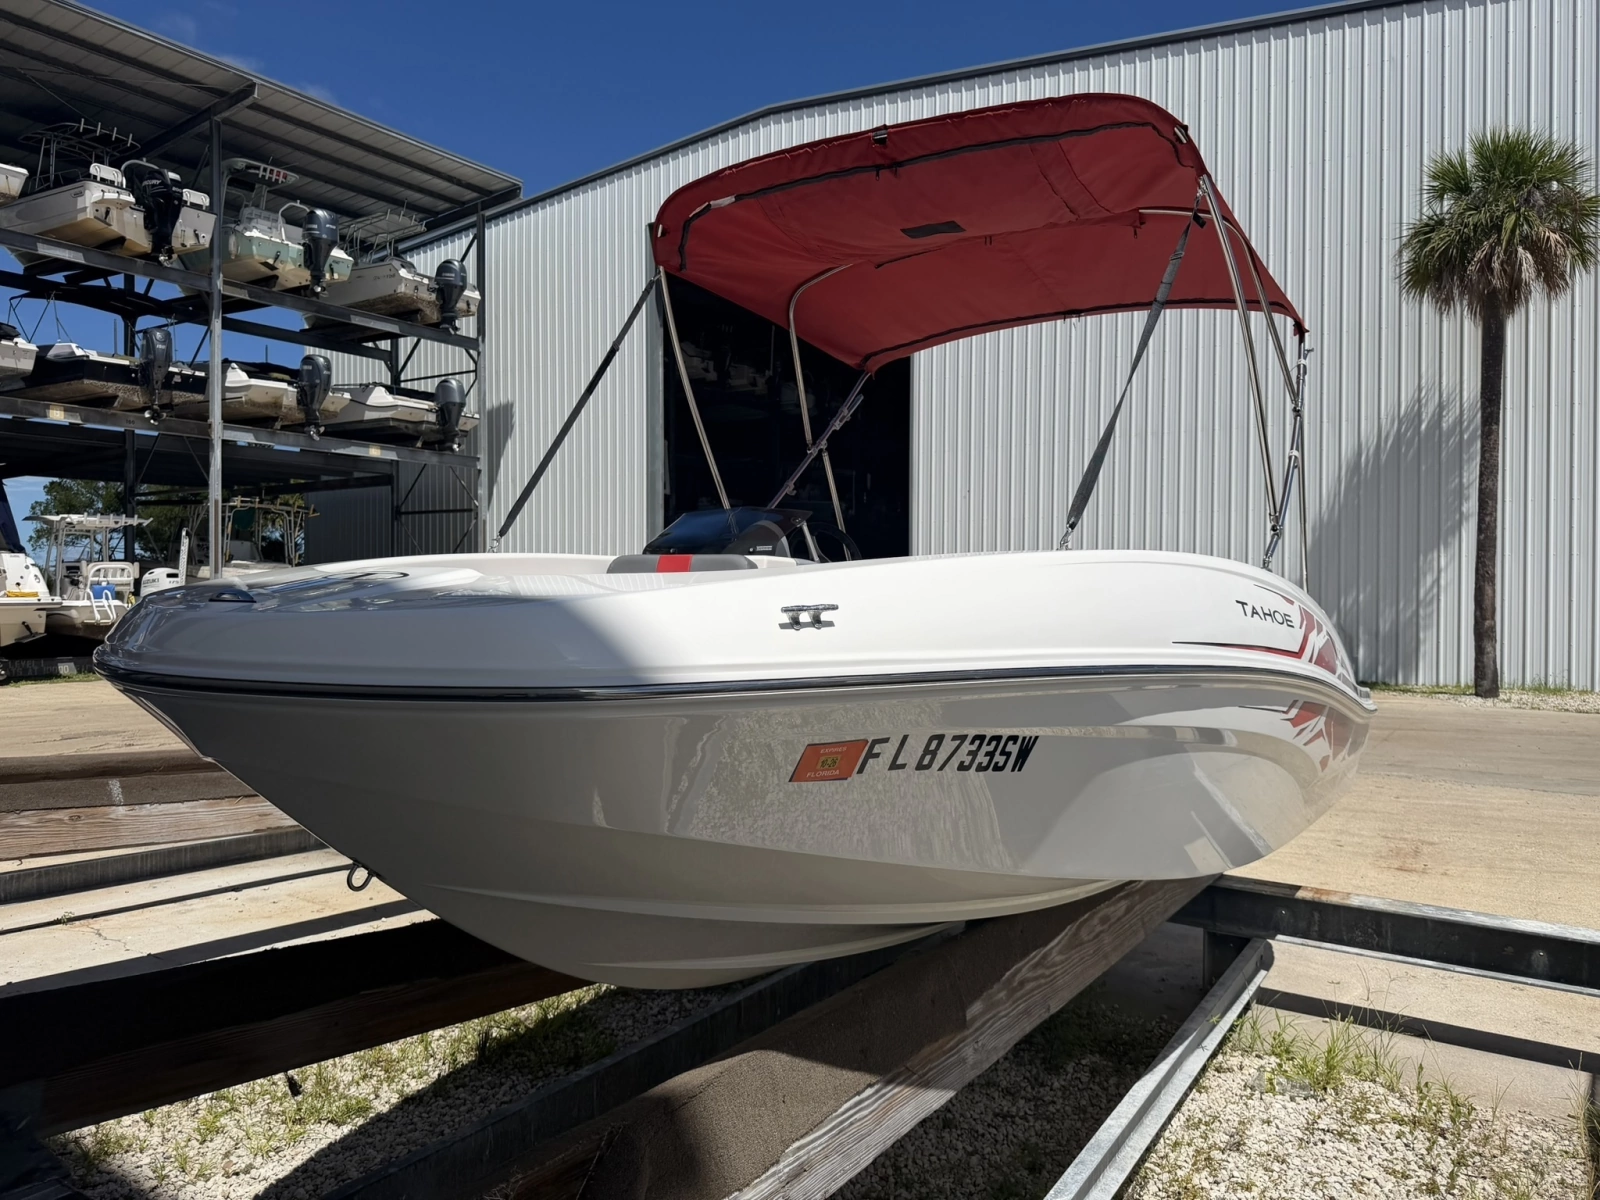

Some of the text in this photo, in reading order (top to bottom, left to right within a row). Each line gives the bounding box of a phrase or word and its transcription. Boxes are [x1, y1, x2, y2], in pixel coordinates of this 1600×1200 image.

[1235, 600, 1295, 628] TAHOE
[820, 746, 847, 754] EXPIRES
[806, 769, 840, 778] FLORIDA
